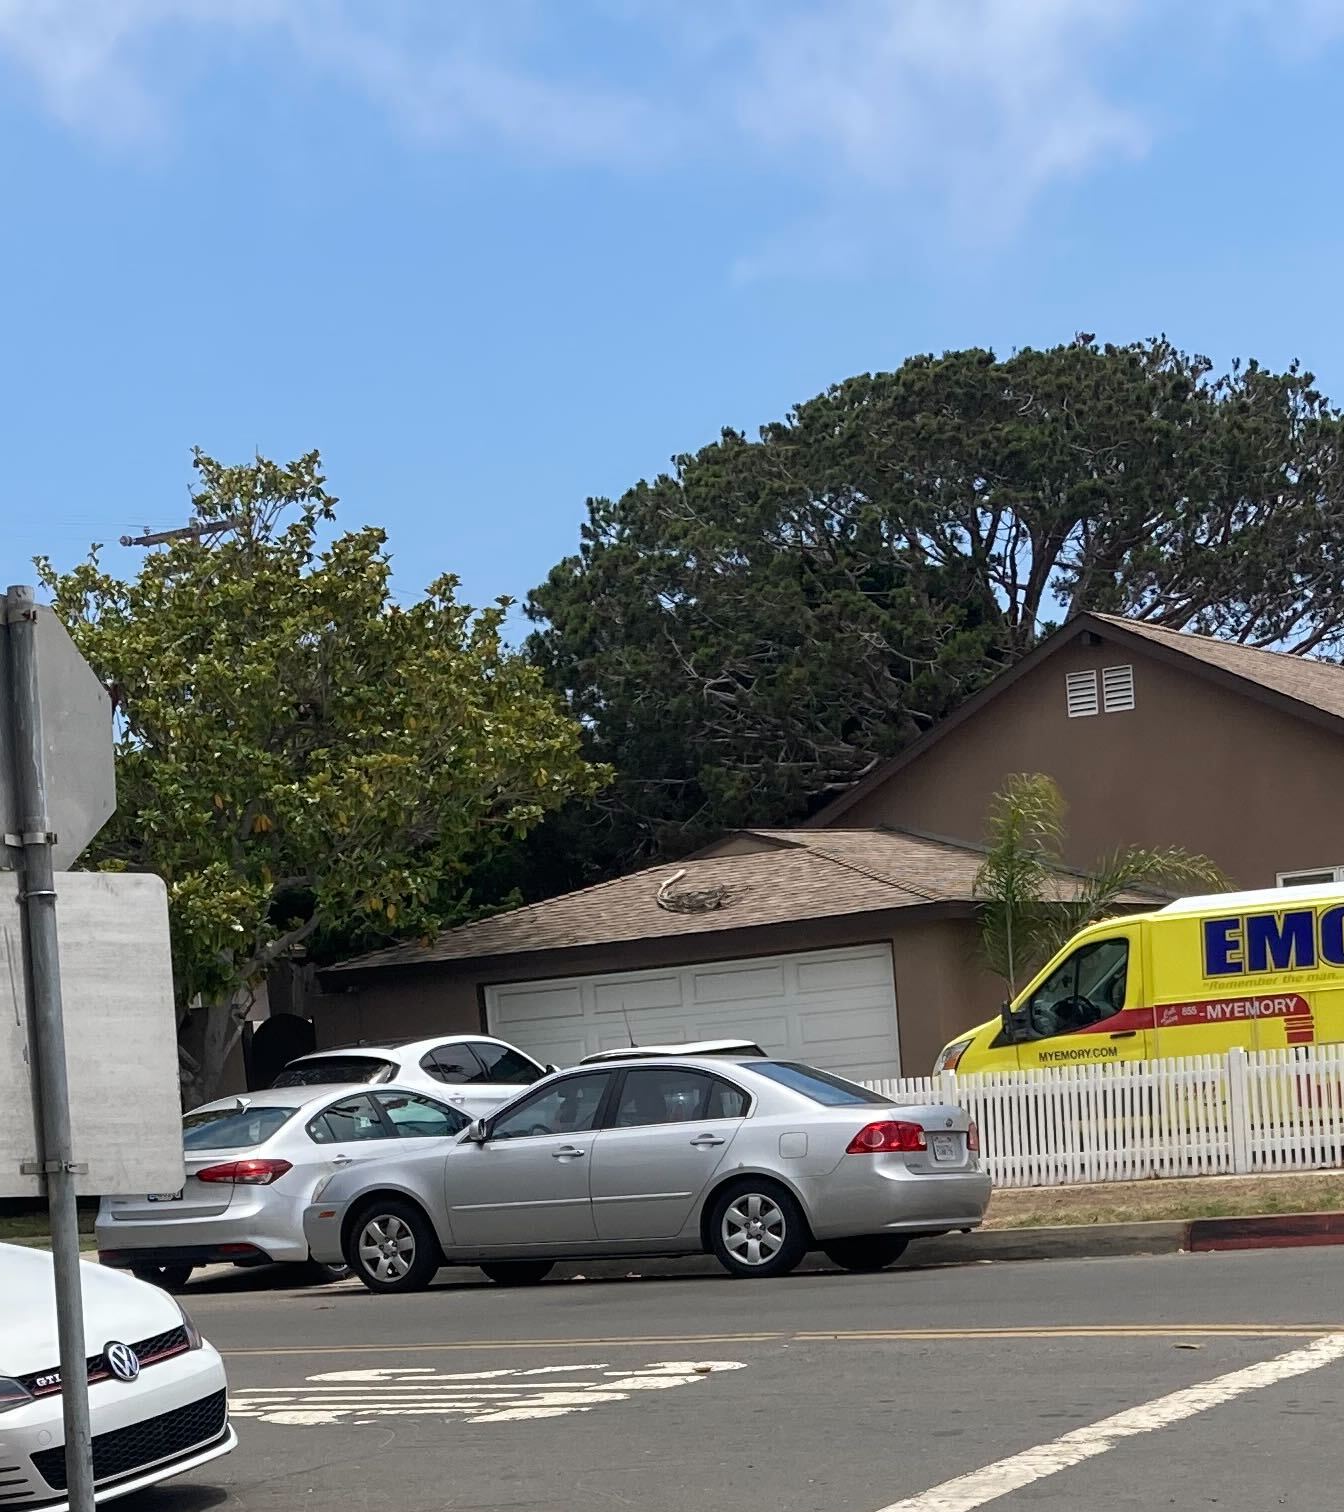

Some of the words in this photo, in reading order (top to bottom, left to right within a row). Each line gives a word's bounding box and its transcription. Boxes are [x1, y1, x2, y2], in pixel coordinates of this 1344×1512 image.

[1282, 974, 1303, 984] the
[1039, 1046, 1118, 1062] MYEMORY.COM
[36, 1373, 62, 1387] GTI
